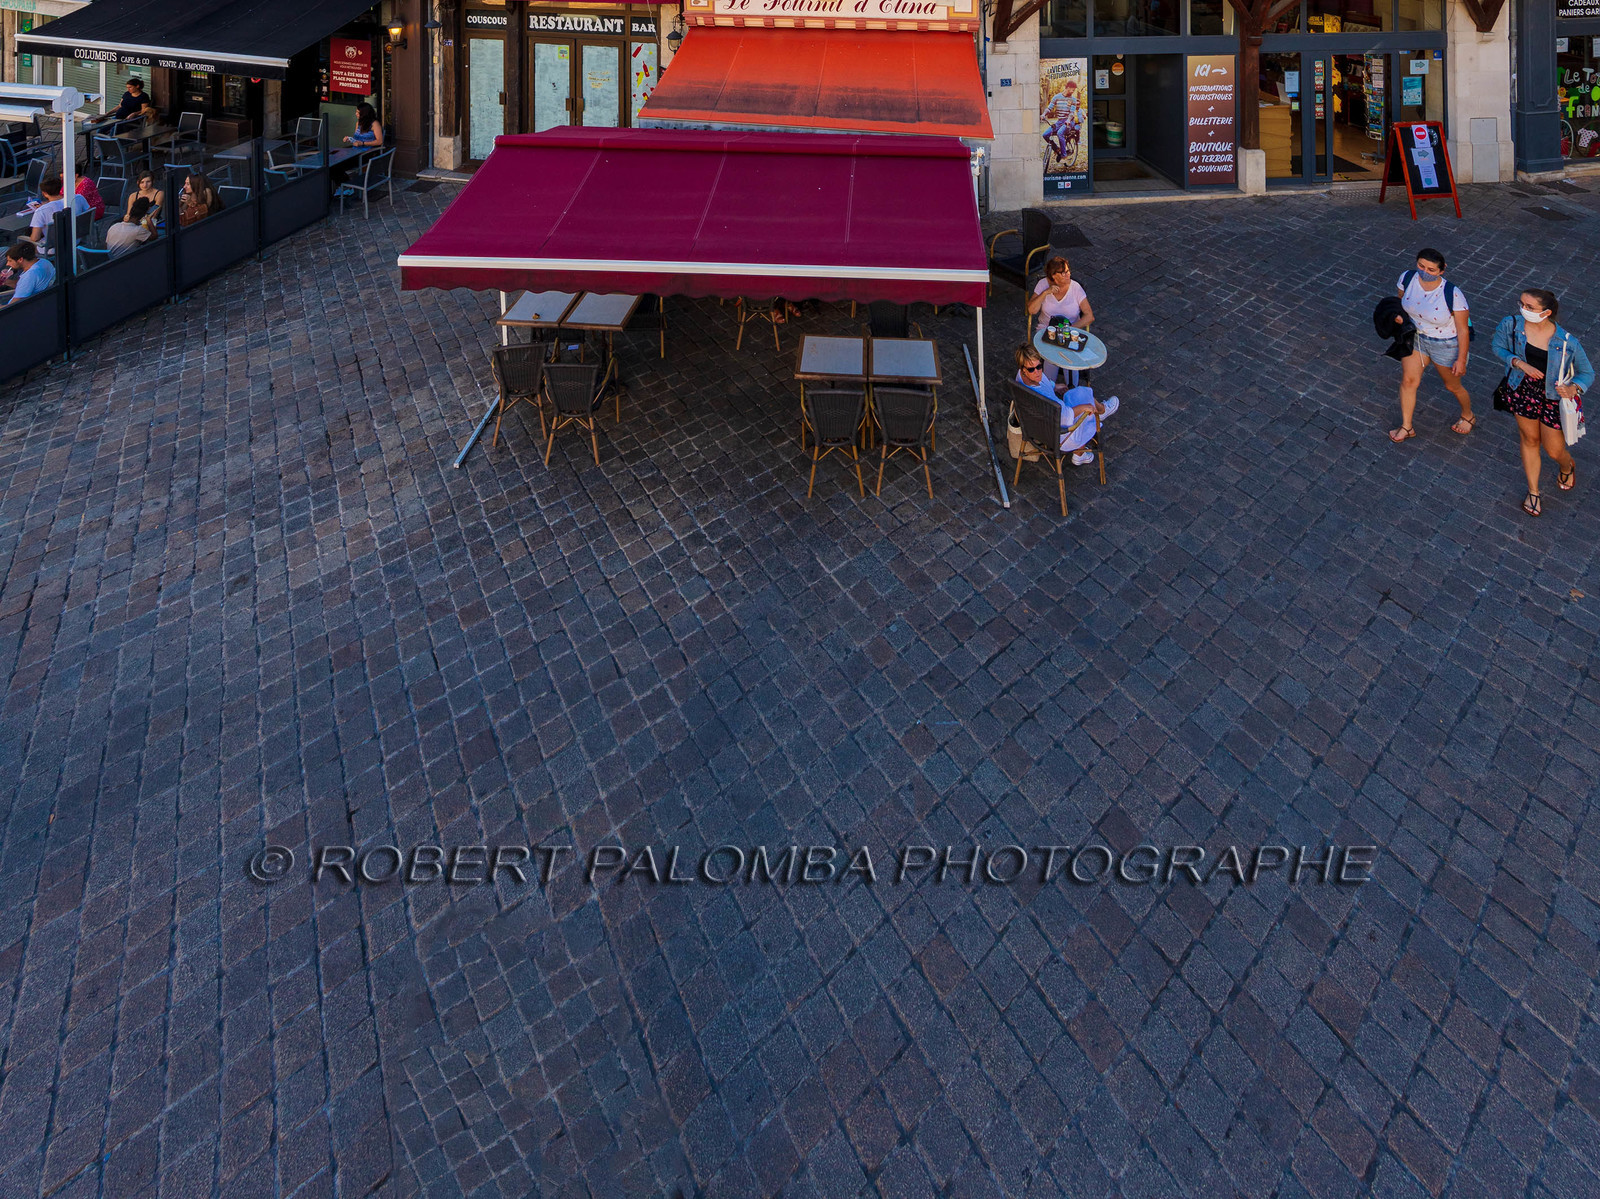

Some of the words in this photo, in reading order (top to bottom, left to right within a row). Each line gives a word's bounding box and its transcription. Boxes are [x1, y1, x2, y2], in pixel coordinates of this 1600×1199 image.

[1558, 8, 1584, 16] PANIERS
[1585, 8, 1600, 16] GAR
[466, 15, 508, 26] COUSCOUS
[529, 14, 624, 34] RESTAURANT
[632, 23, 656, 33] BAR
[74, 48, 118, 62] COLUMBUS
[158, 60, 176, 69] VENTE
[184, 62, 216, 73] EMPORTER
[1052, 62, 1072, 73] VIENNE
[1194, 64, 1211, 77] ICI
[1564, 69, 1580, 84] Le
[1578, 82, 1590, 93] de
[1189, 117, 1233, 126] BILLETTERIE
[1189, 142, 1233, 154] BOUTIQUE
[1189, 155, 1200, 163] DU
[1201, 154, 1234, 163] TERROIR
[1197, 164, 1233, 173] SOUVENIRS
